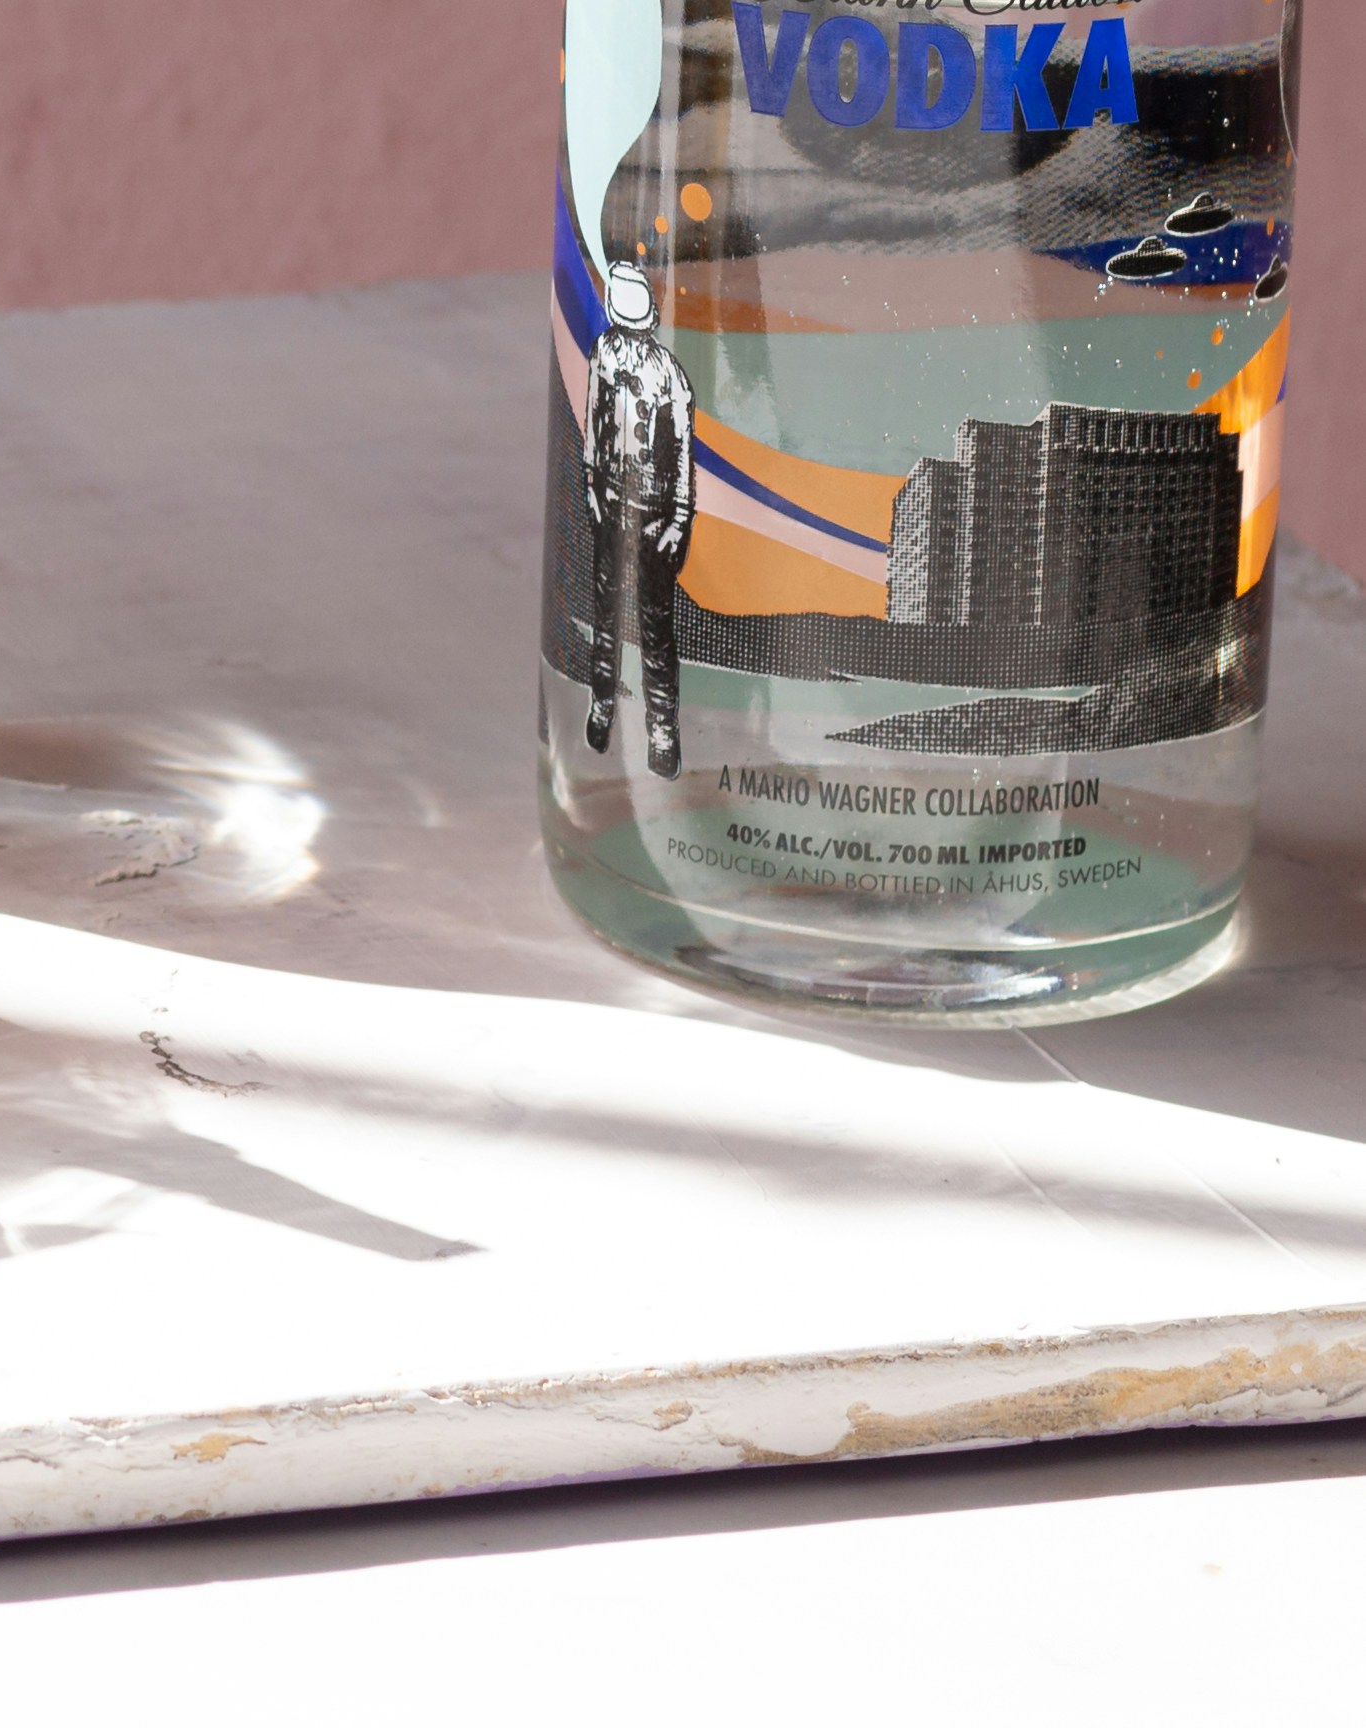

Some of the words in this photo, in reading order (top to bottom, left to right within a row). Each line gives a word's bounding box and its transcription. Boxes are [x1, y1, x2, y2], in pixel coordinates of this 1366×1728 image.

[731, 0, 1140, 132] VODKA
[718, 764, 731, 792] A
[738, 768, 810, 806] MARIO
[818, 781, 917, 816] WAGNER
[925, 777, 1100, 816] COLLABORATION
[668, 837, 777, 878] PRODUCED
[785, 865, 836, 887] AND
[845, 873, 941, 894] BOTTLED
[950, 876, 973, 894] IN
[983, 871, 1050, 894] ÅHUS,
[1058, 856, 1142, 888] SWEDEN
[726, 823, 771, 849] 40%
[775, 832, 882, 863] ALC./VOL.
[888, 845, 932, 864] 700
[937, 845, 970, 865] ML
[979, 837, 1086, 864] IMPORTED
